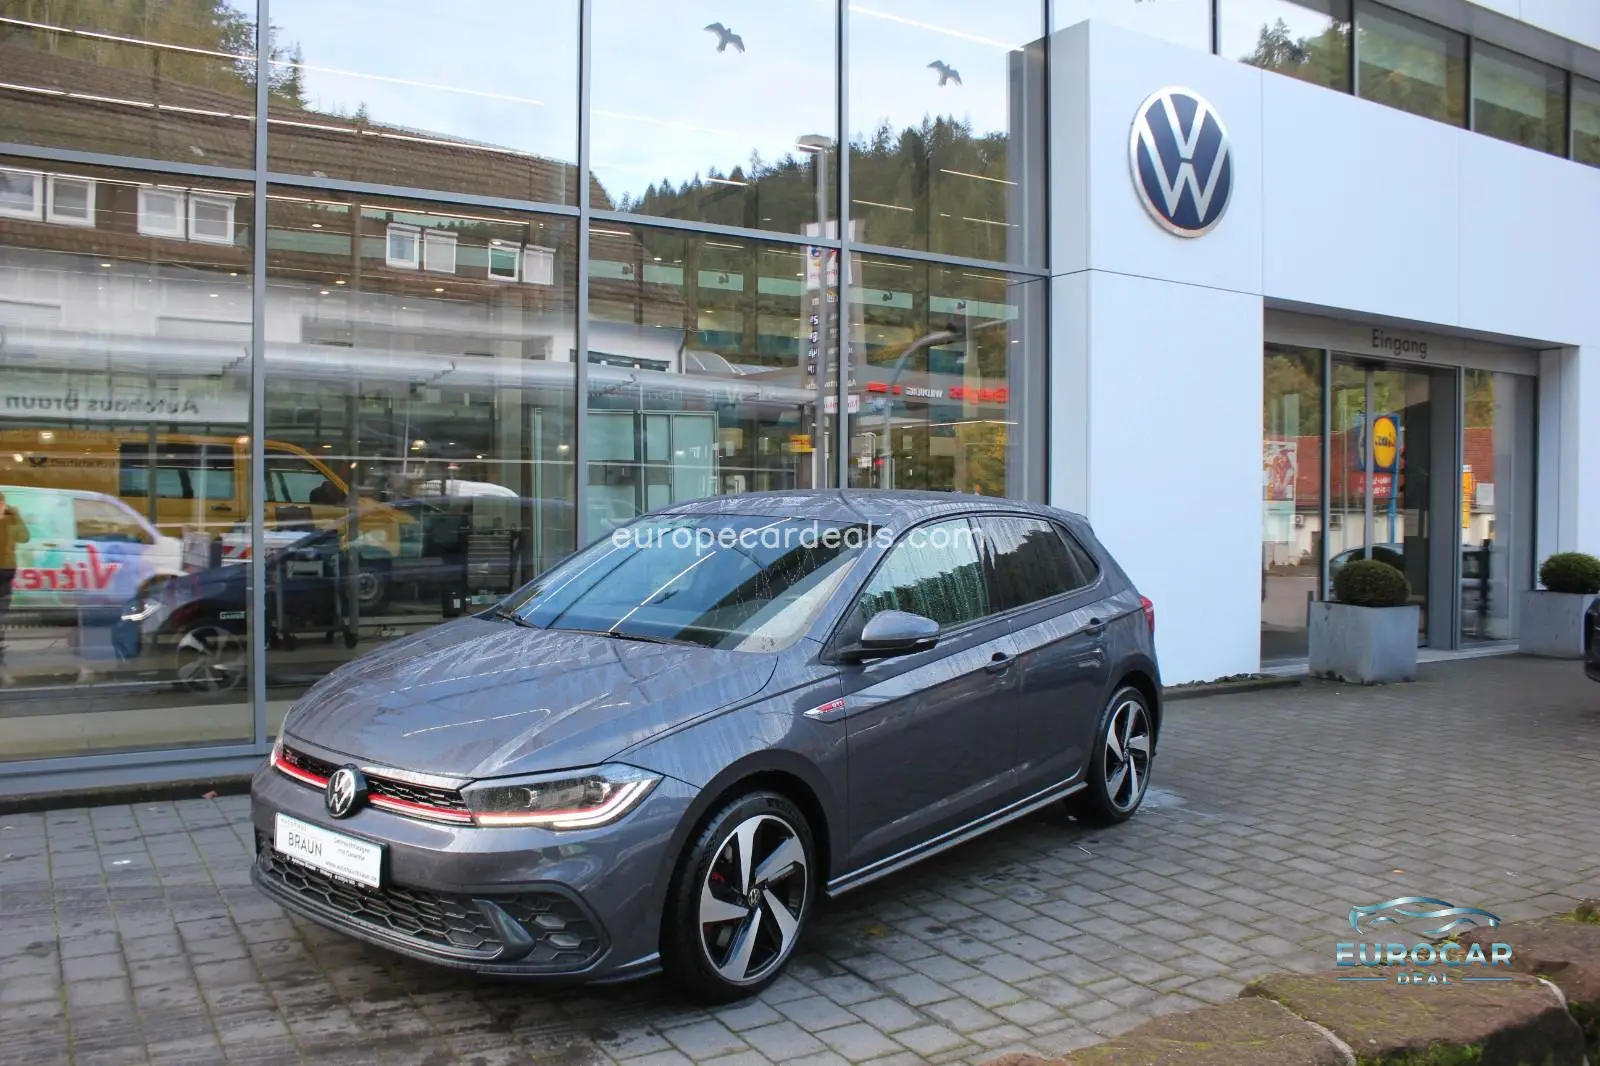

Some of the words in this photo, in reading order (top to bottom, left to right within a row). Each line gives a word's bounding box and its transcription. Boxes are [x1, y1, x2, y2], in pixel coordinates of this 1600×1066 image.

[1128, 85, 1234, 239] VW
[1371, 328, 1427, 359] Eingang
[288, 831, 322, 857] BRAUN
